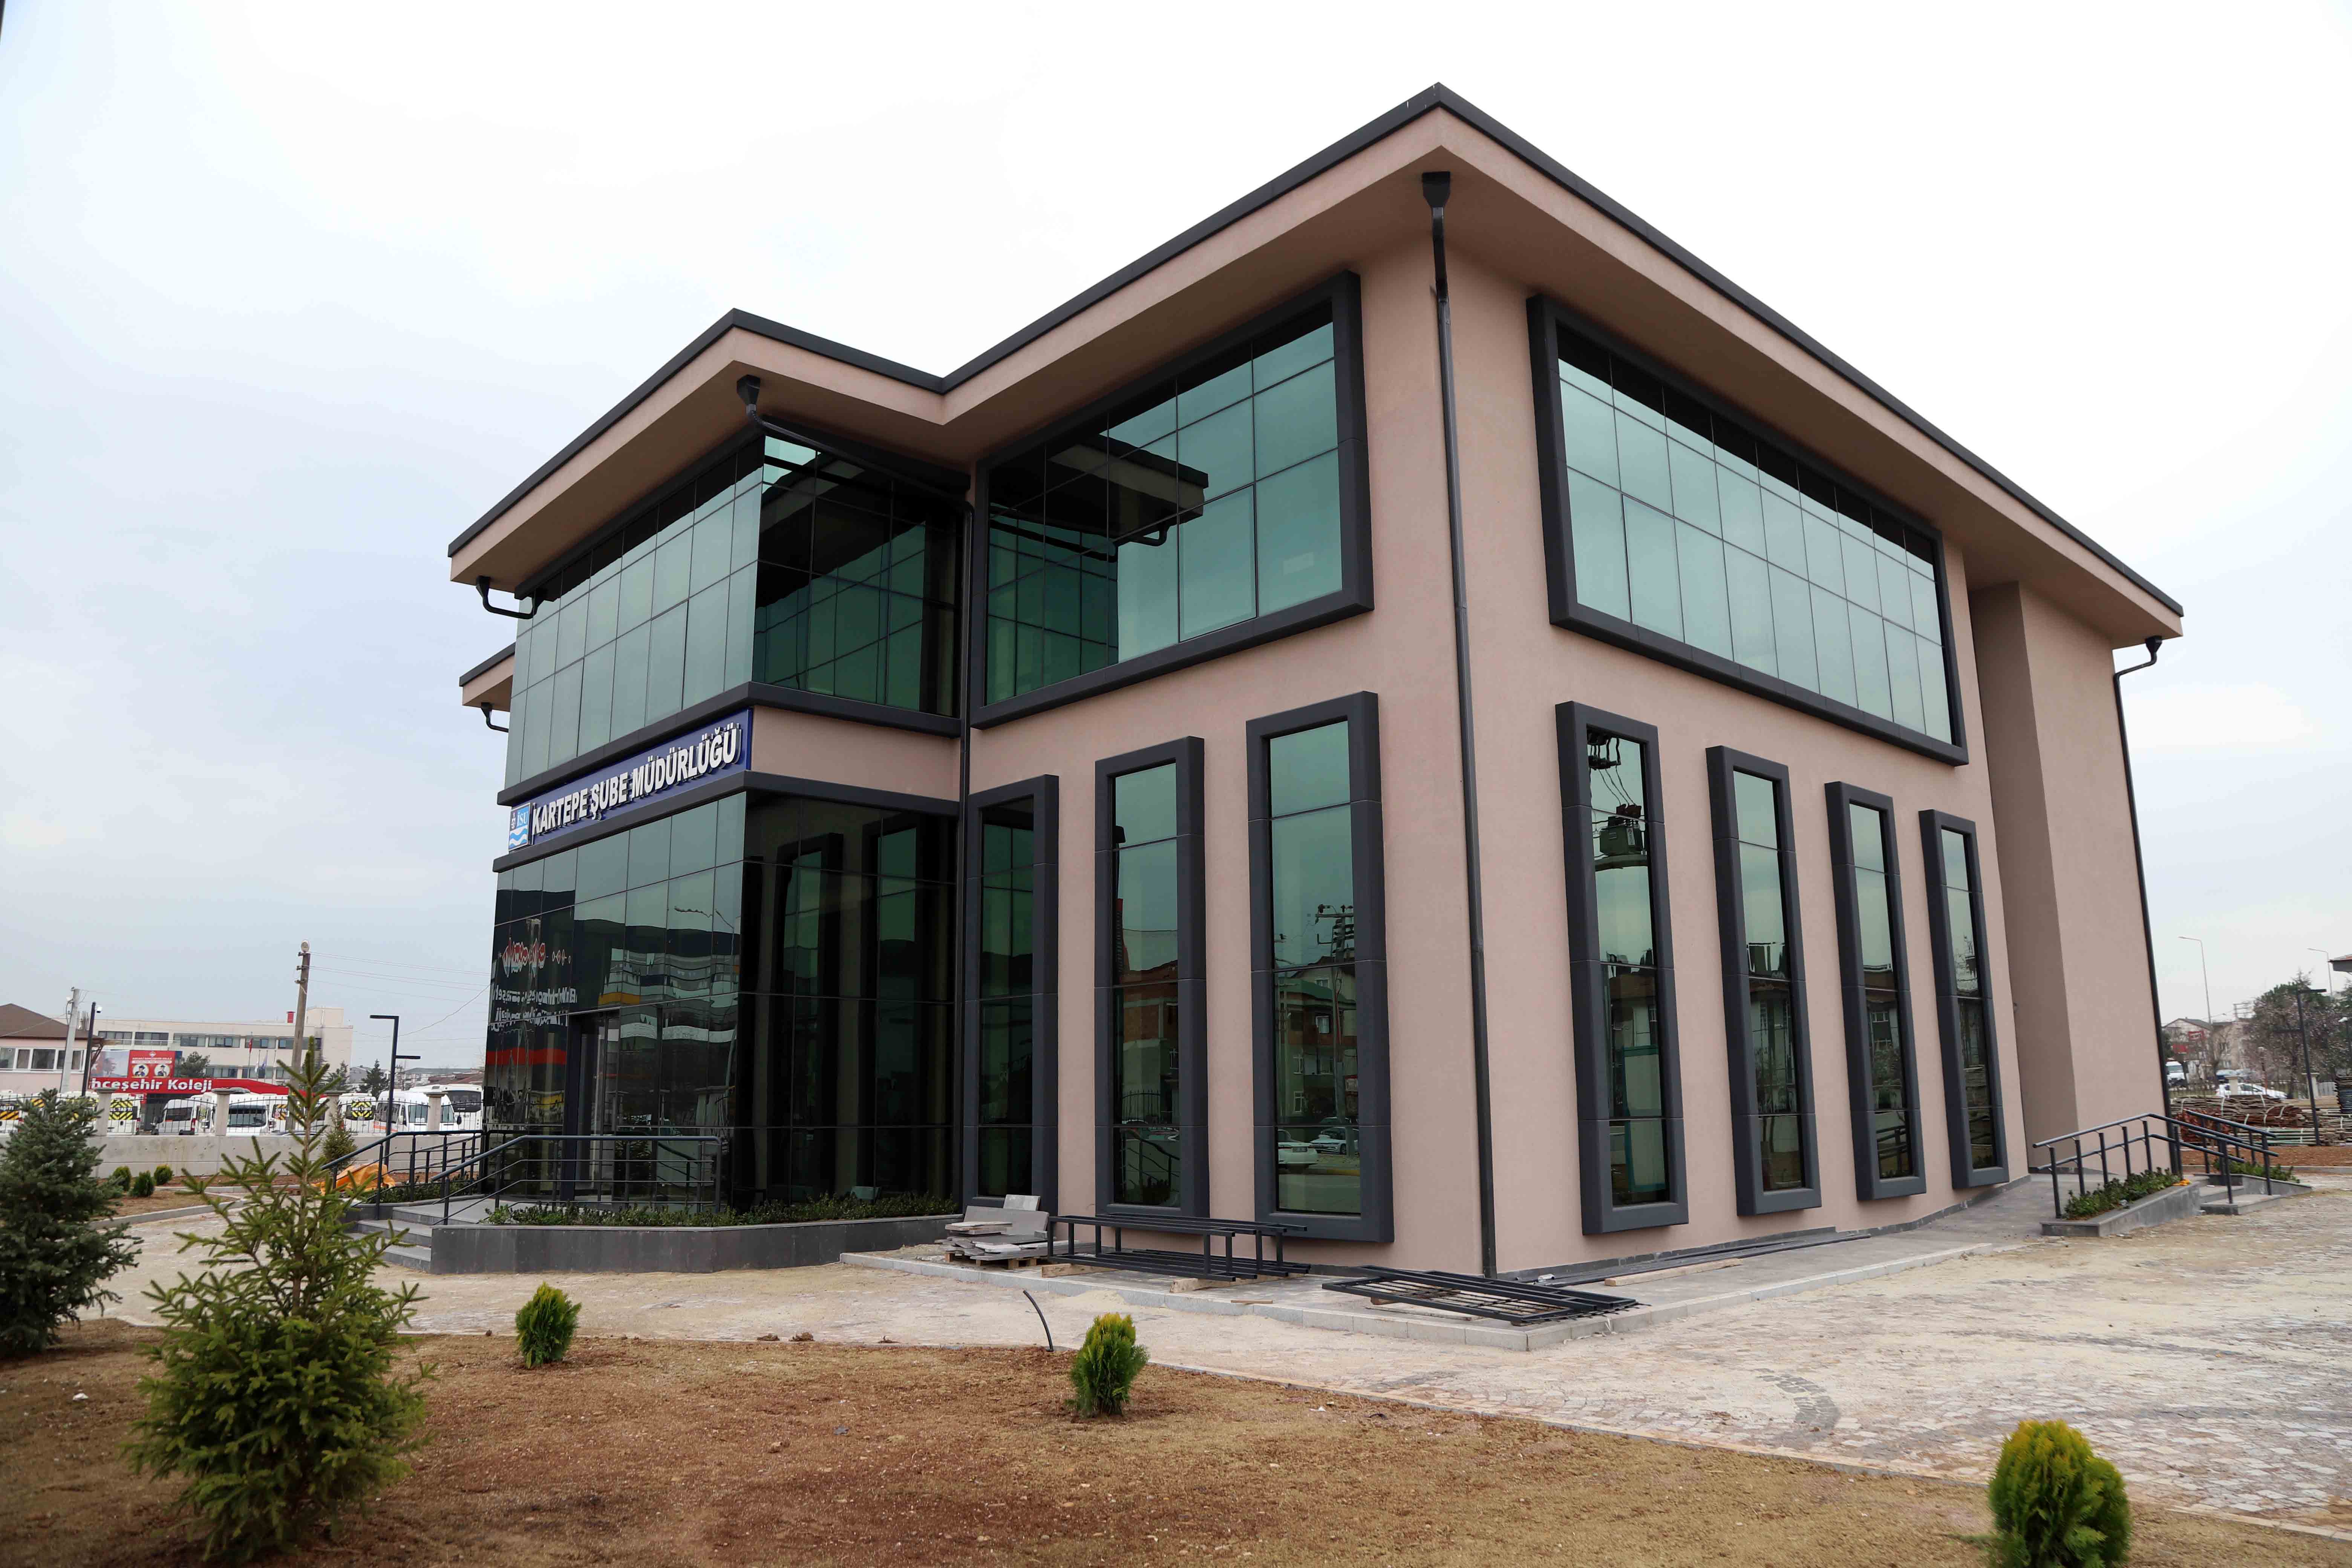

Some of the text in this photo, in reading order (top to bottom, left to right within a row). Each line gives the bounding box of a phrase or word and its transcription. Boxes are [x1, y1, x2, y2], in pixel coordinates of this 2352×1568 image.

[532, 722, 737, 835] KARTEPE ŞUBE MÜDÜRLÜĞÜ
[168, 1079, 212, 1092] Koleji
